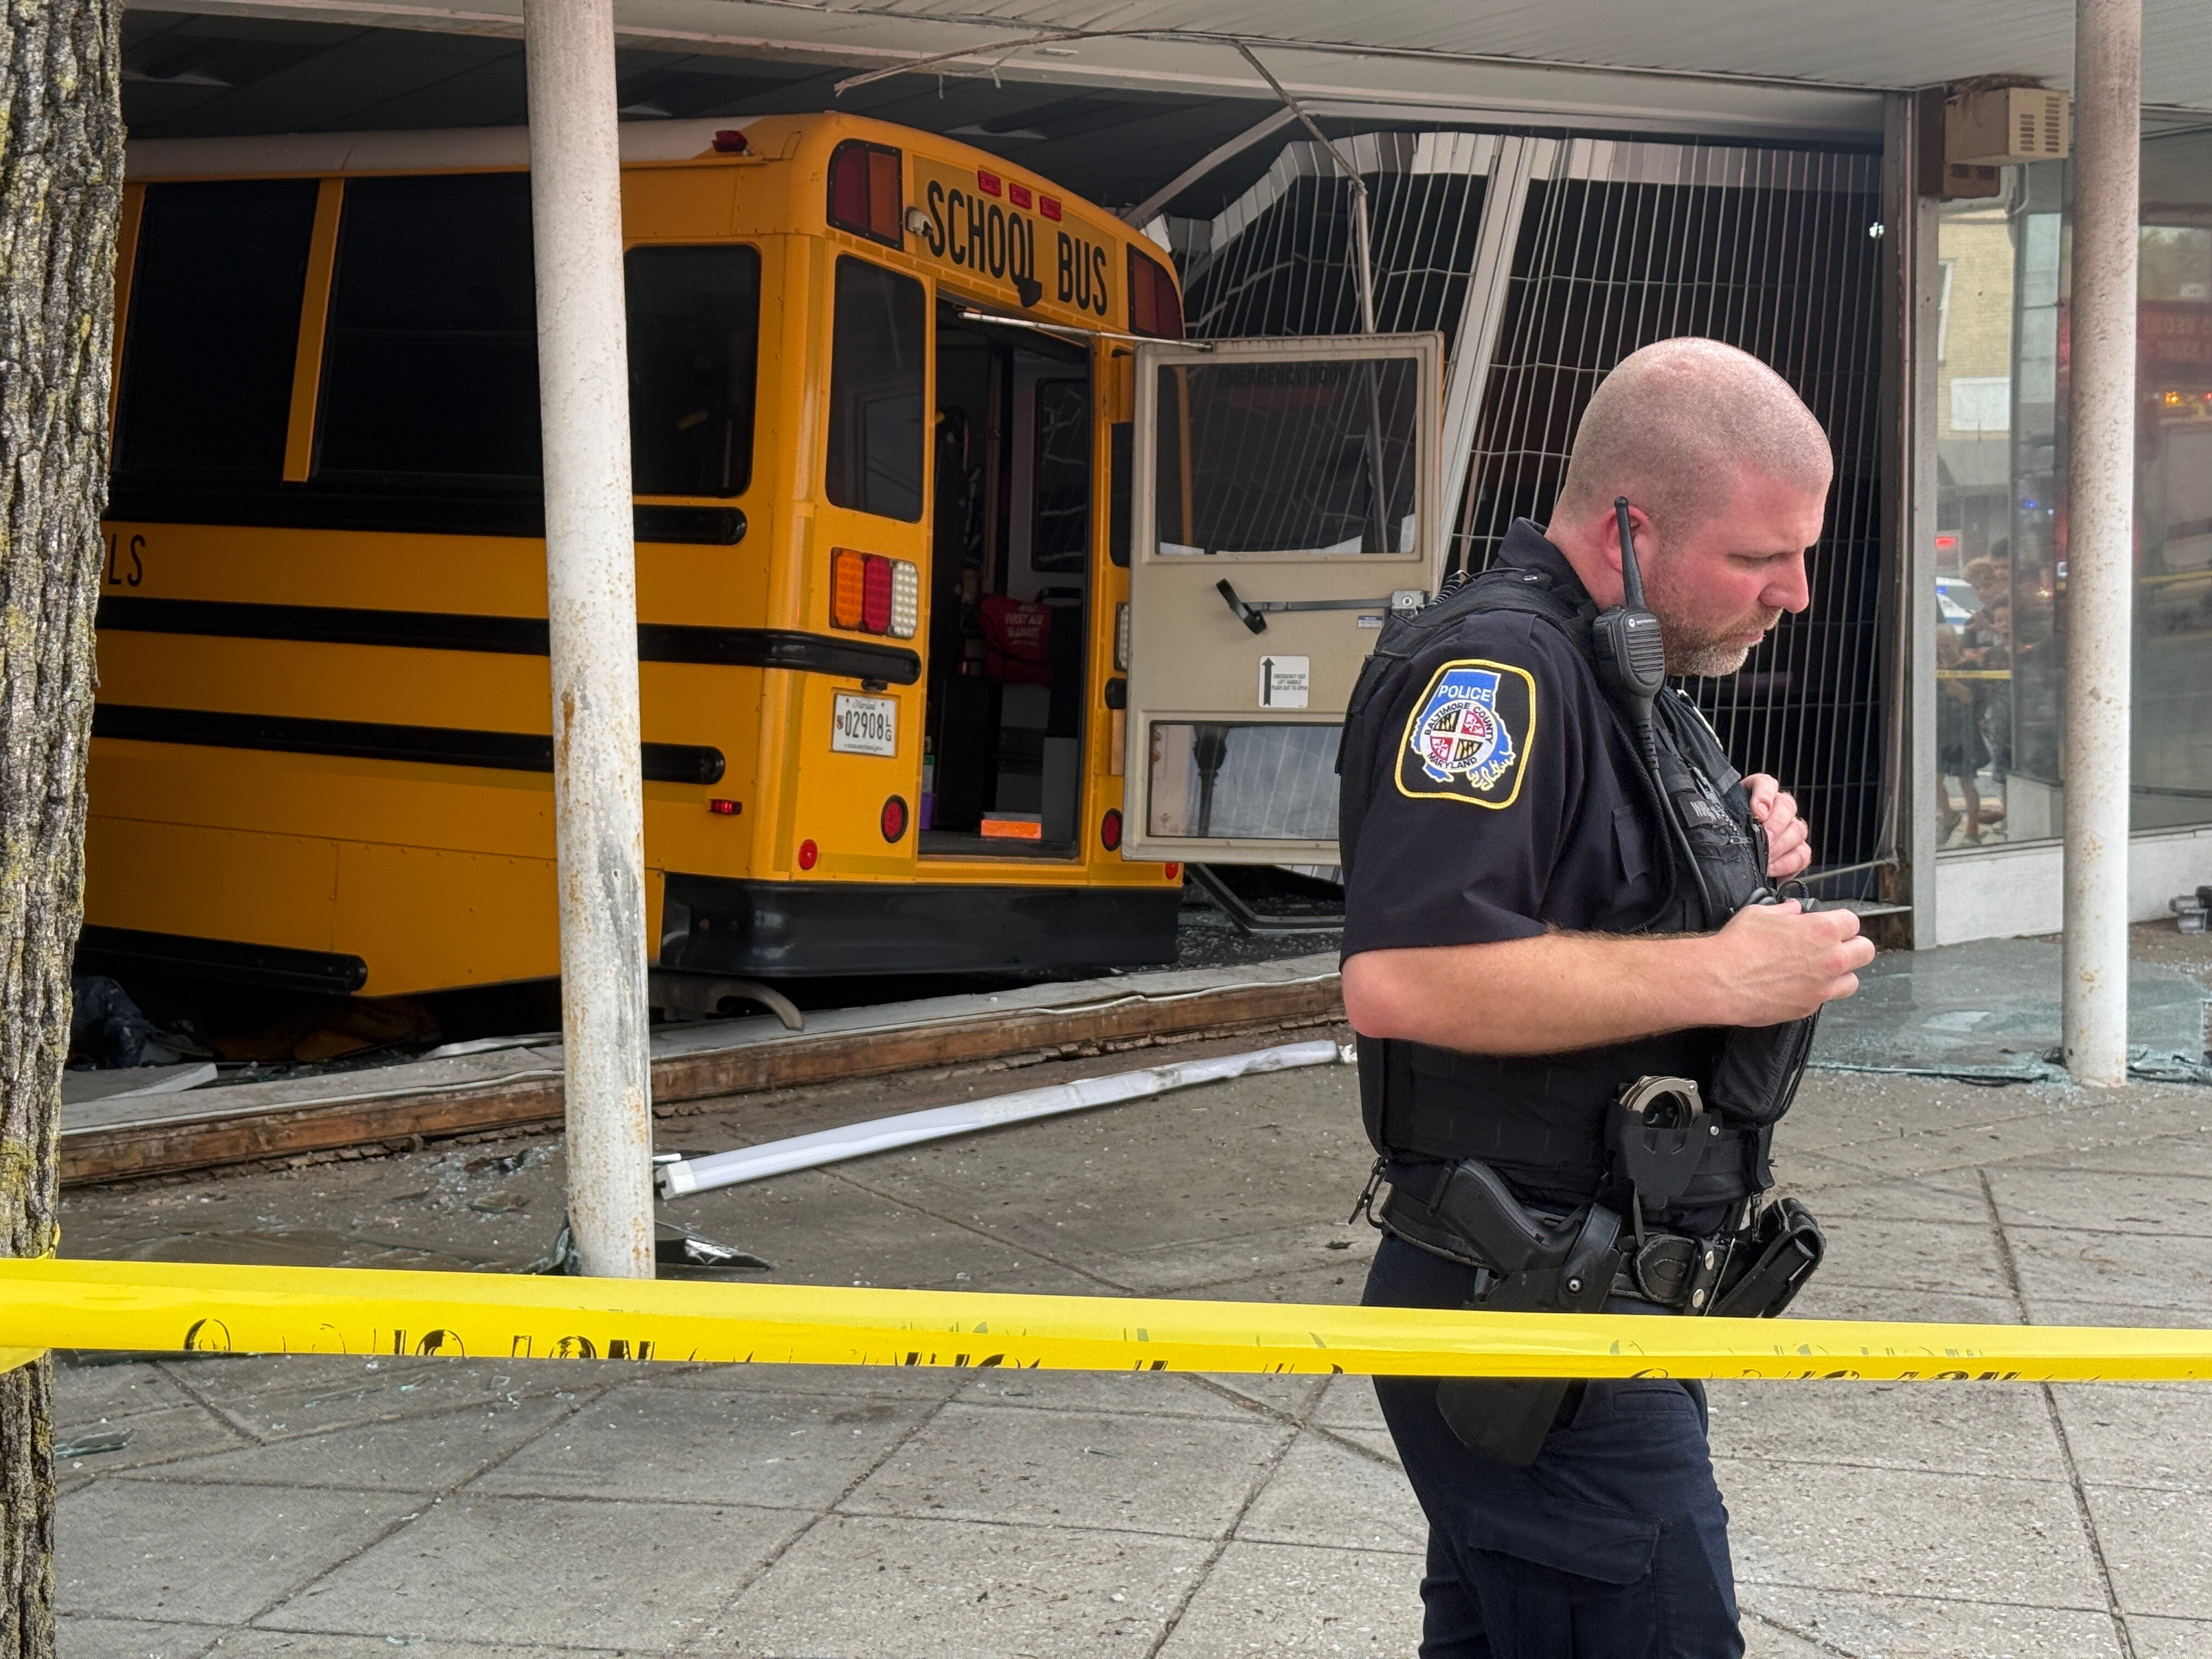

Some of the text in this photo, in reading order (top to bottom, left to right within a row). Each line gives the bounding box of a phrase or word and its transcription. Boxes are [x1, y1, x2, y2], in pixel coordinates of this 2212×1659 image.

[927, 180, 1107, 316] SCHOOL BUS
[1218, 366, 1350, 386] EMERGENCY DOOR
[1437, 685, 1492, 702] POLICE
[845, 710, 884, 740] 02908
[1424, 702, 1494, 745] BALTIMORE COUNTY
[1427, 753, 1477, 769] MARYLAND
